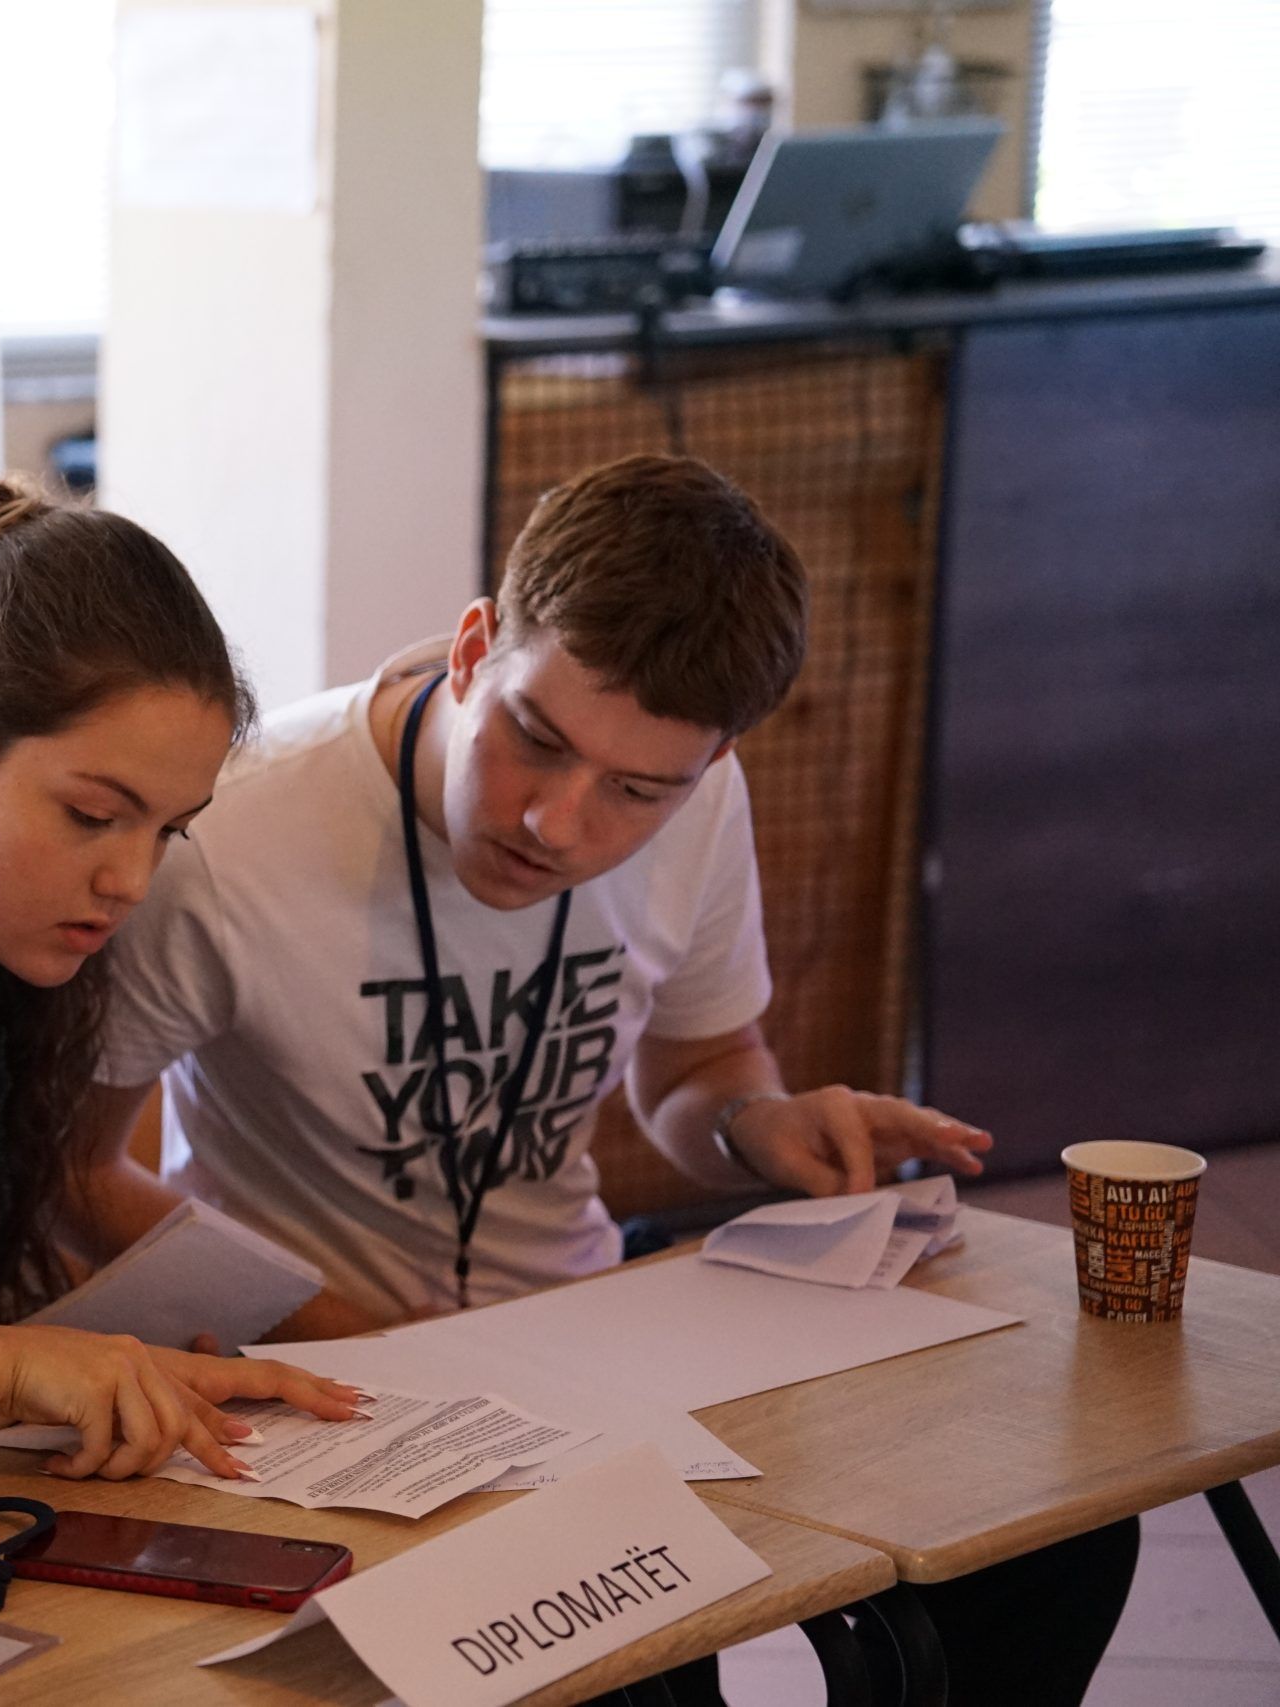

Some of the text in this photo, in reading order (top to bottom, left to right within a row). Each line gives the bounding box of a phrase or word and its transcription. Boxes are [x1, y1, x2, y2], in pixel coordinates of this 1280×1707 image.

[360, 945, 627, 1065] TAKE
[361, 1026, 618, 1142] YOUR
[1106, 1185, 1132, 1204] AU
[1120, 1204, 1140, 1221] TO
[450, 1545, 692, 1677] DIPLOMATËT
